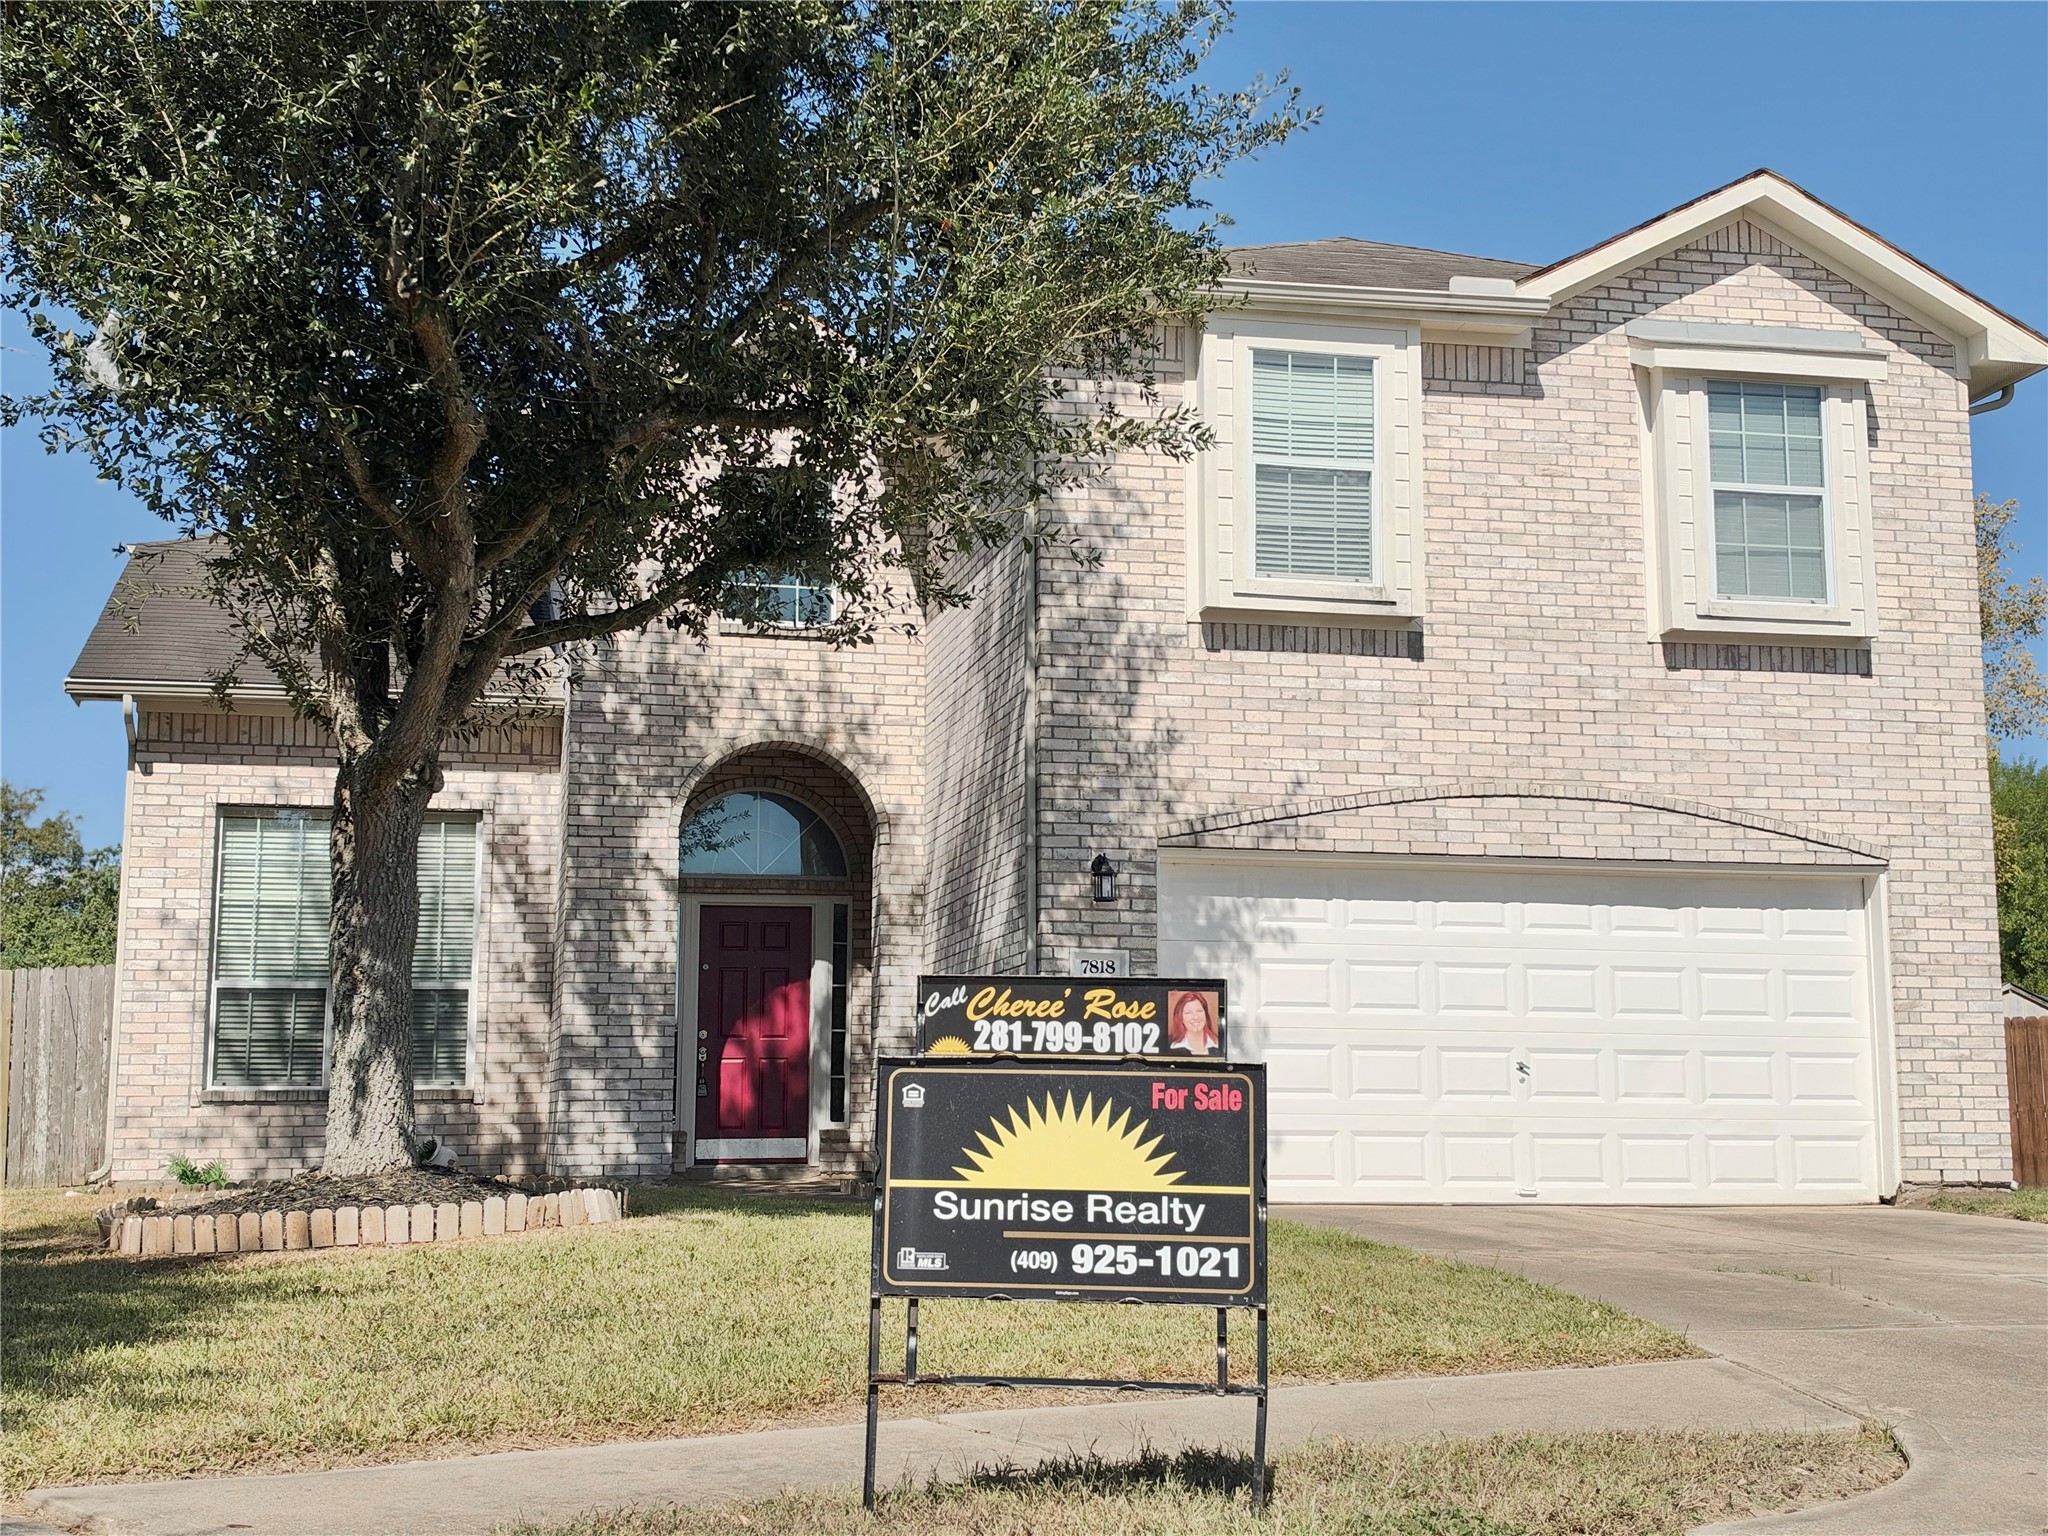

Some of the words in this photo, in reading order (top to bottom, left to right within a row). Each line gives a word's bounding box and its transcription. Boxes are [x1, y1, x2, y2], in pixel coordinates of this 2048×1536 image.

[1080, 960, 1116, 975] 7818
[924, 984, 969, 1017] Call
[1083, 988, 1157, 1020] Rose
[973, 1019, 1161, 1054] 281-799-8102
[1151, 1082, 1189, 1111] For
[1193, 1083, 1243, 1112] Sale
[932, 1190, 1074, 1223] Sunrise
[1086, 1194, 1206, 1232] Realty
[917, 1257, 943, 1268] MLS
[1010, 1250, 1059, 1274] (409)
[1071, 1243, 1239, 1278] 925-1021
